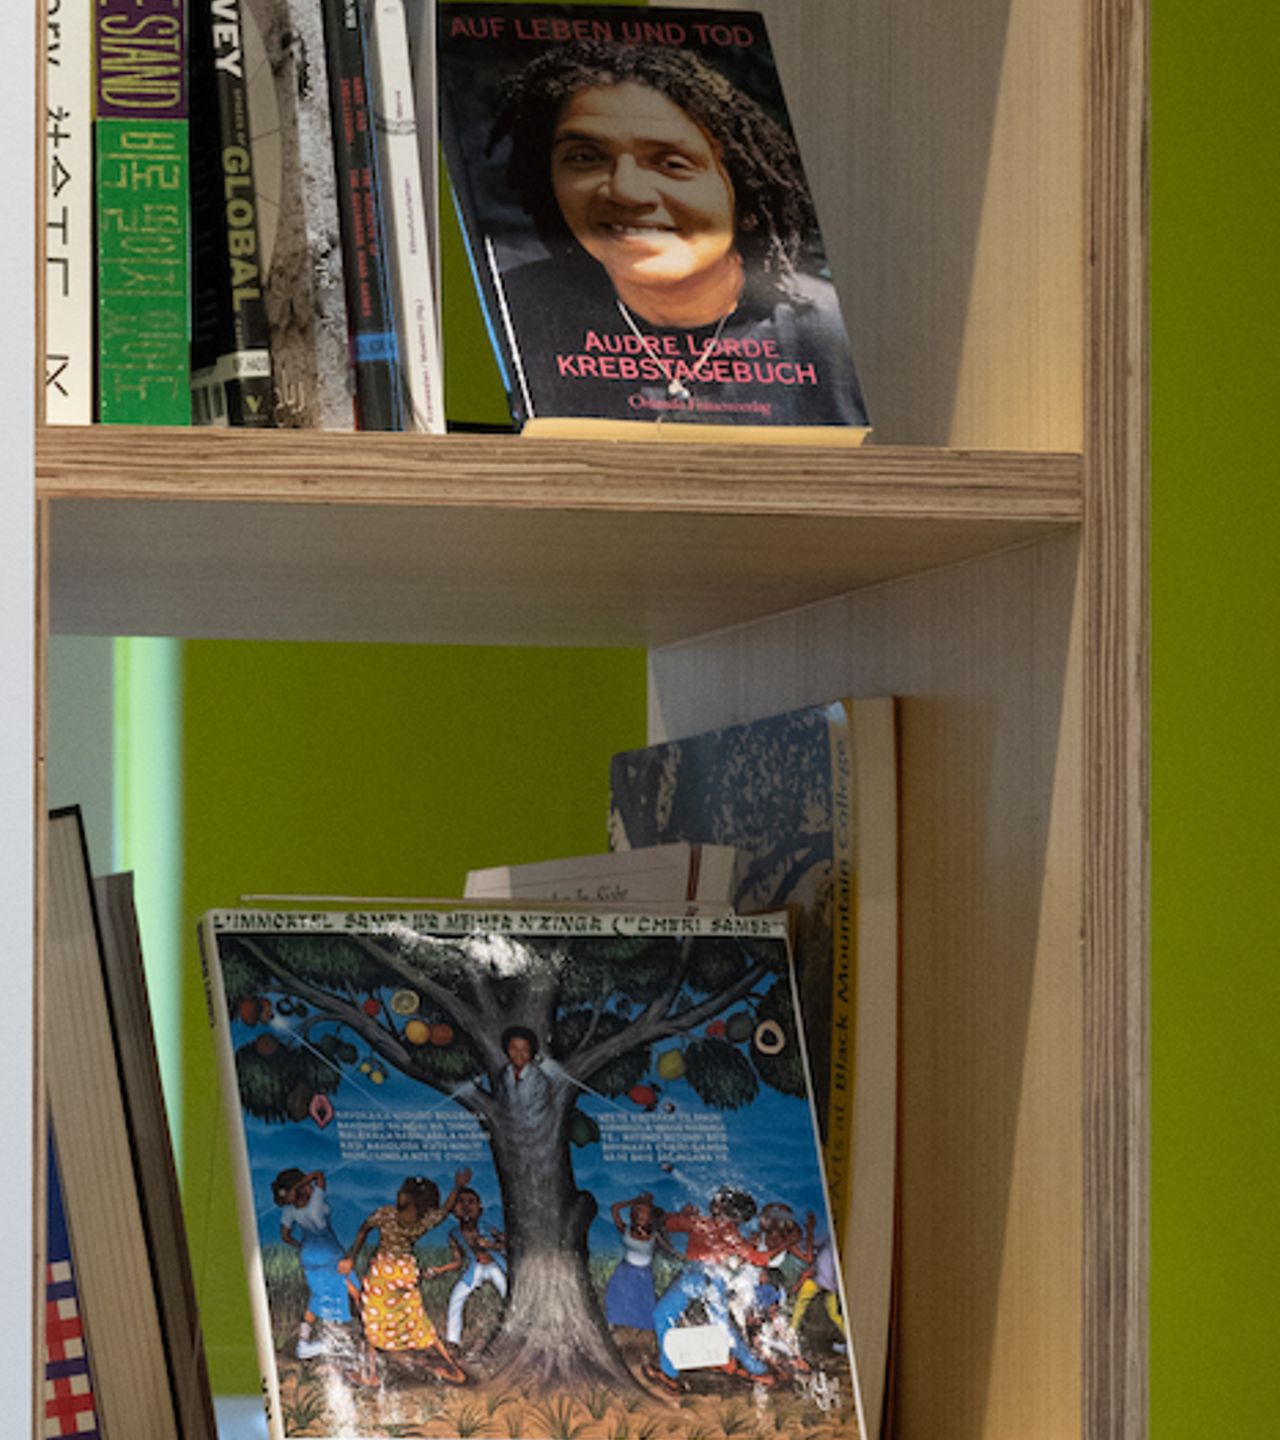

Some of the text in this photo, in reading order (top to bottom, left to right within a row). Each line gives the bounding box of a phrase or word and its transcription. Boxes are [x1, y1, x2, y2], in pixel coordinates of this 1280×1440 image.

[99, 8, 182, 112] STAND
[450, 16, 755, 48] AUF LEBEN UND TOD
[220, 145, 262, 305] GLOBAL
[556, 356, 819, 385] KREBSTAGEBUCH
[584, 329, 781, 359] AUDRE LORDE
[833, 858, 852, 1003] Mountain
[832, 1014, 851, 1093] Black
